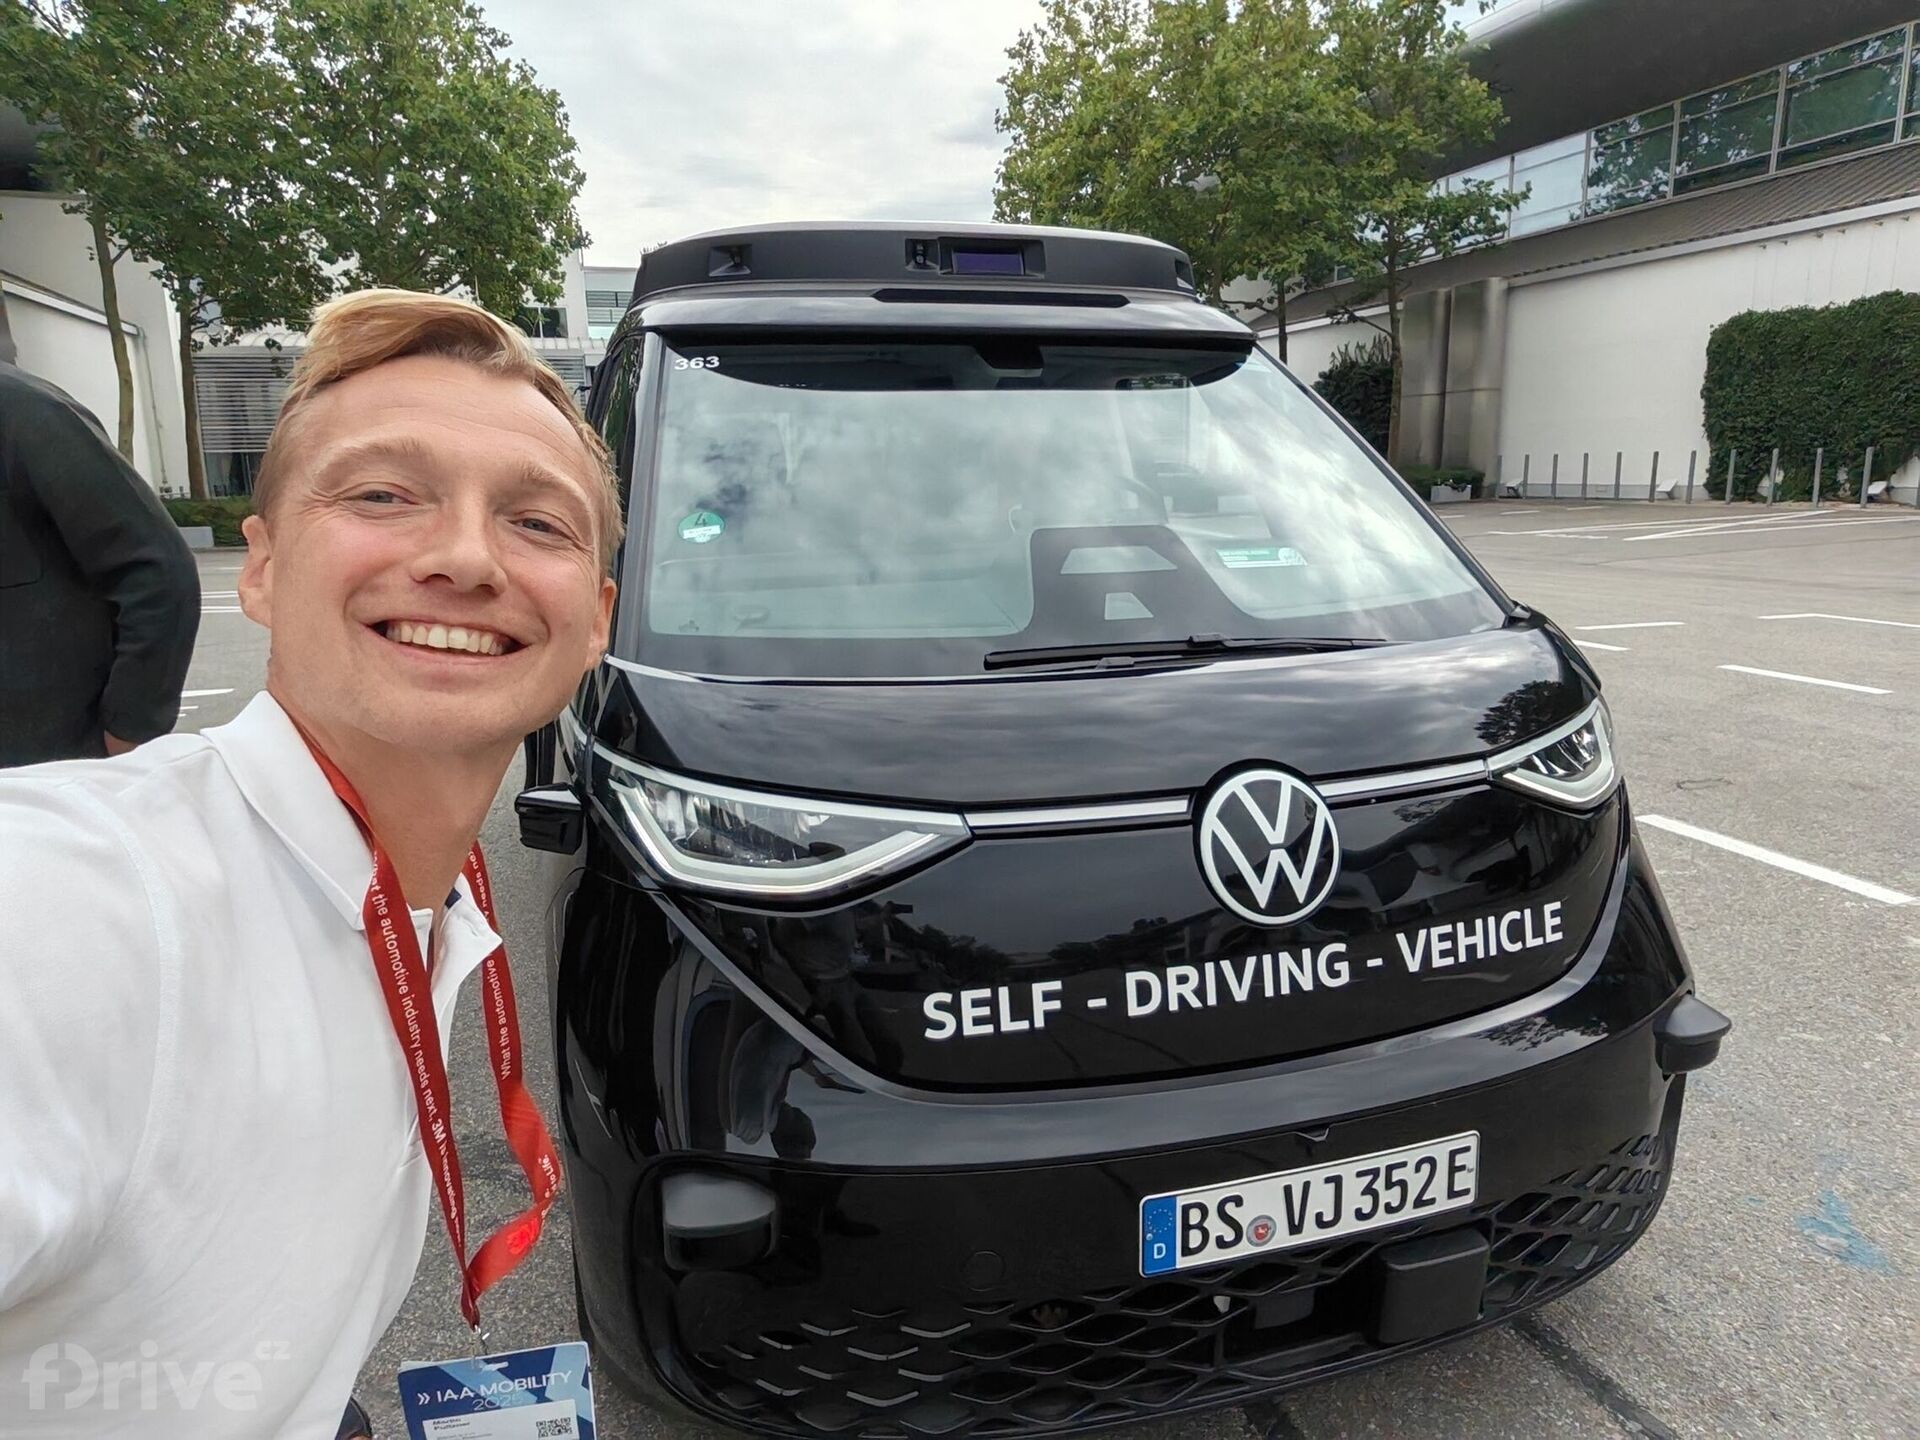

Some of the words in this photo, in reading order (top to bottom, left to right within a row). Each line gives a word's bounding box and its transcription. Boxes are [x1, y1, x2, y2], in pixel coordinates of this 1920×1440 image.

[674, 356, 720, 370] 363
[476, 871, 489, 908] needs
[922, 980, 1063, 1040] SELF
[1125, 943, 1351, 1017] DRIVING
[1395, 901, 1564, 974] VEHICLE
[486, 959, 507, 1026] automotive
[371, 893, 389, 916] the
[380, 917, 410, 995] automotive
[401, 994, 421, 1049] industry
[414, 1050, 430, 1089] needs
[423, 1088, 438, 1122] next,
[432, 1118, 447, 1143] 3M
[498, 1026, 510, 1047] the
[500, 1046, 512, 1080] What
[1153, 1243, 1167, 1260] D
[436, 1386, 476, 1402] IAA
[480, 1370, 572, 1397] MOBILITY
